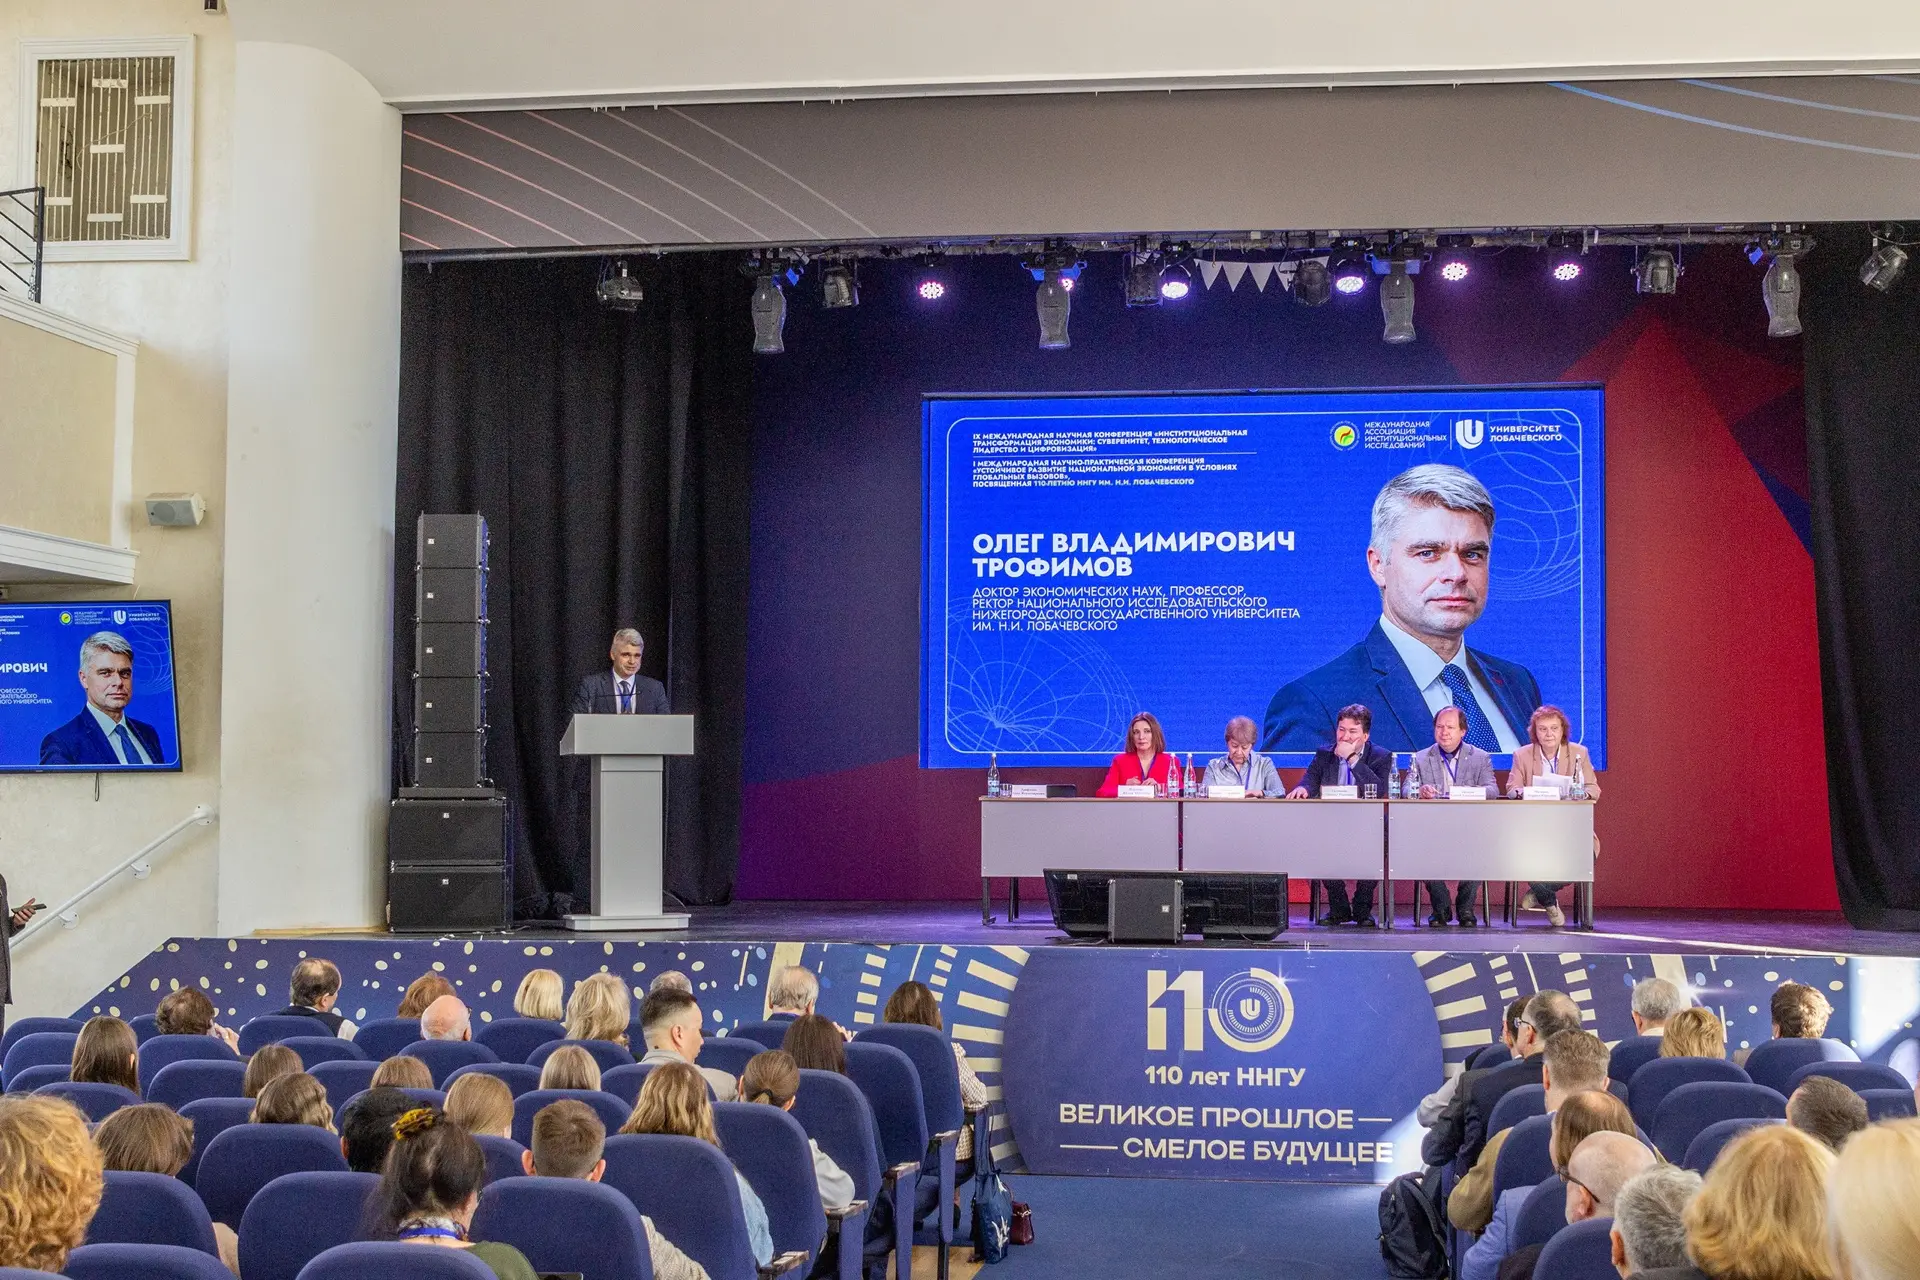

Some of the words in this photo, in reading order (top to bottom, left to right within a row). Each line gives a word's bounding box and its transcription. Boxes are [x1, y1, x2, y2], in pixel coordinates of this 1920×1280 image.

[1489, 425, 1560, 433] УНИВЕРСИТЕТ
[1490, 434, 1562, 442] ЛОБАЧЕВСКОГО
[1068, 465, 1134, 473] НАЦИОНАЛЬНОЙ
[972, 533, 1044, 554] ОЛЕГ
[1052, 531, 1295, 554] ВЛАДИМИРОВИЧ
[972, 557, 1133, 578] ТРОФИМОВ
[972, 587, 1019, 599] ДОКТОР
[1023, 586, 1129, 597] ЭКОНОМИЧЕСКИХ
[1132, 586, 1167, 598] НАУК,
[1170, 586, 1247, 598] ПРОФЕССОР,
[972, 598, 1014, 609] РЕКТОР
[1017, 598, 1125, 610] НАЦИОНАЛЬНОГО
[1128, 597, 1268, 609] ИССЛЕДОВАТЕЛЬСКОГО
[972, 609, 1084, 621] НИЖЕГОРОДСКОГО
[1088, 608, 1208, 621] ГОСУДАРСТВЕННОГО
[1212, 608, 1300, 619] УНИВЕРСИТЕТА
[972, 620, 994, 631] ИМ.
[998, 620, 1023, 631] Н.И.
[1027, 620, 1118, 631] ЛОБАЧЕВСКОГО
[1144, 1066, 1183, 1085] 110
[1189, 1070, 1230, 1086] лет
[1237, 1067, 1306, 1087] ННГУ
[1059, 1103, 1194, 1127] ВЕЛИКОЕ
[1202, 1106, 1354, 1129] ПРОШЛОЕ
[1123, 1137, 1245, 1160] СМЕЛОЕ
[1253, 1140, 1394, 1166] БУДУЩЕЕ
